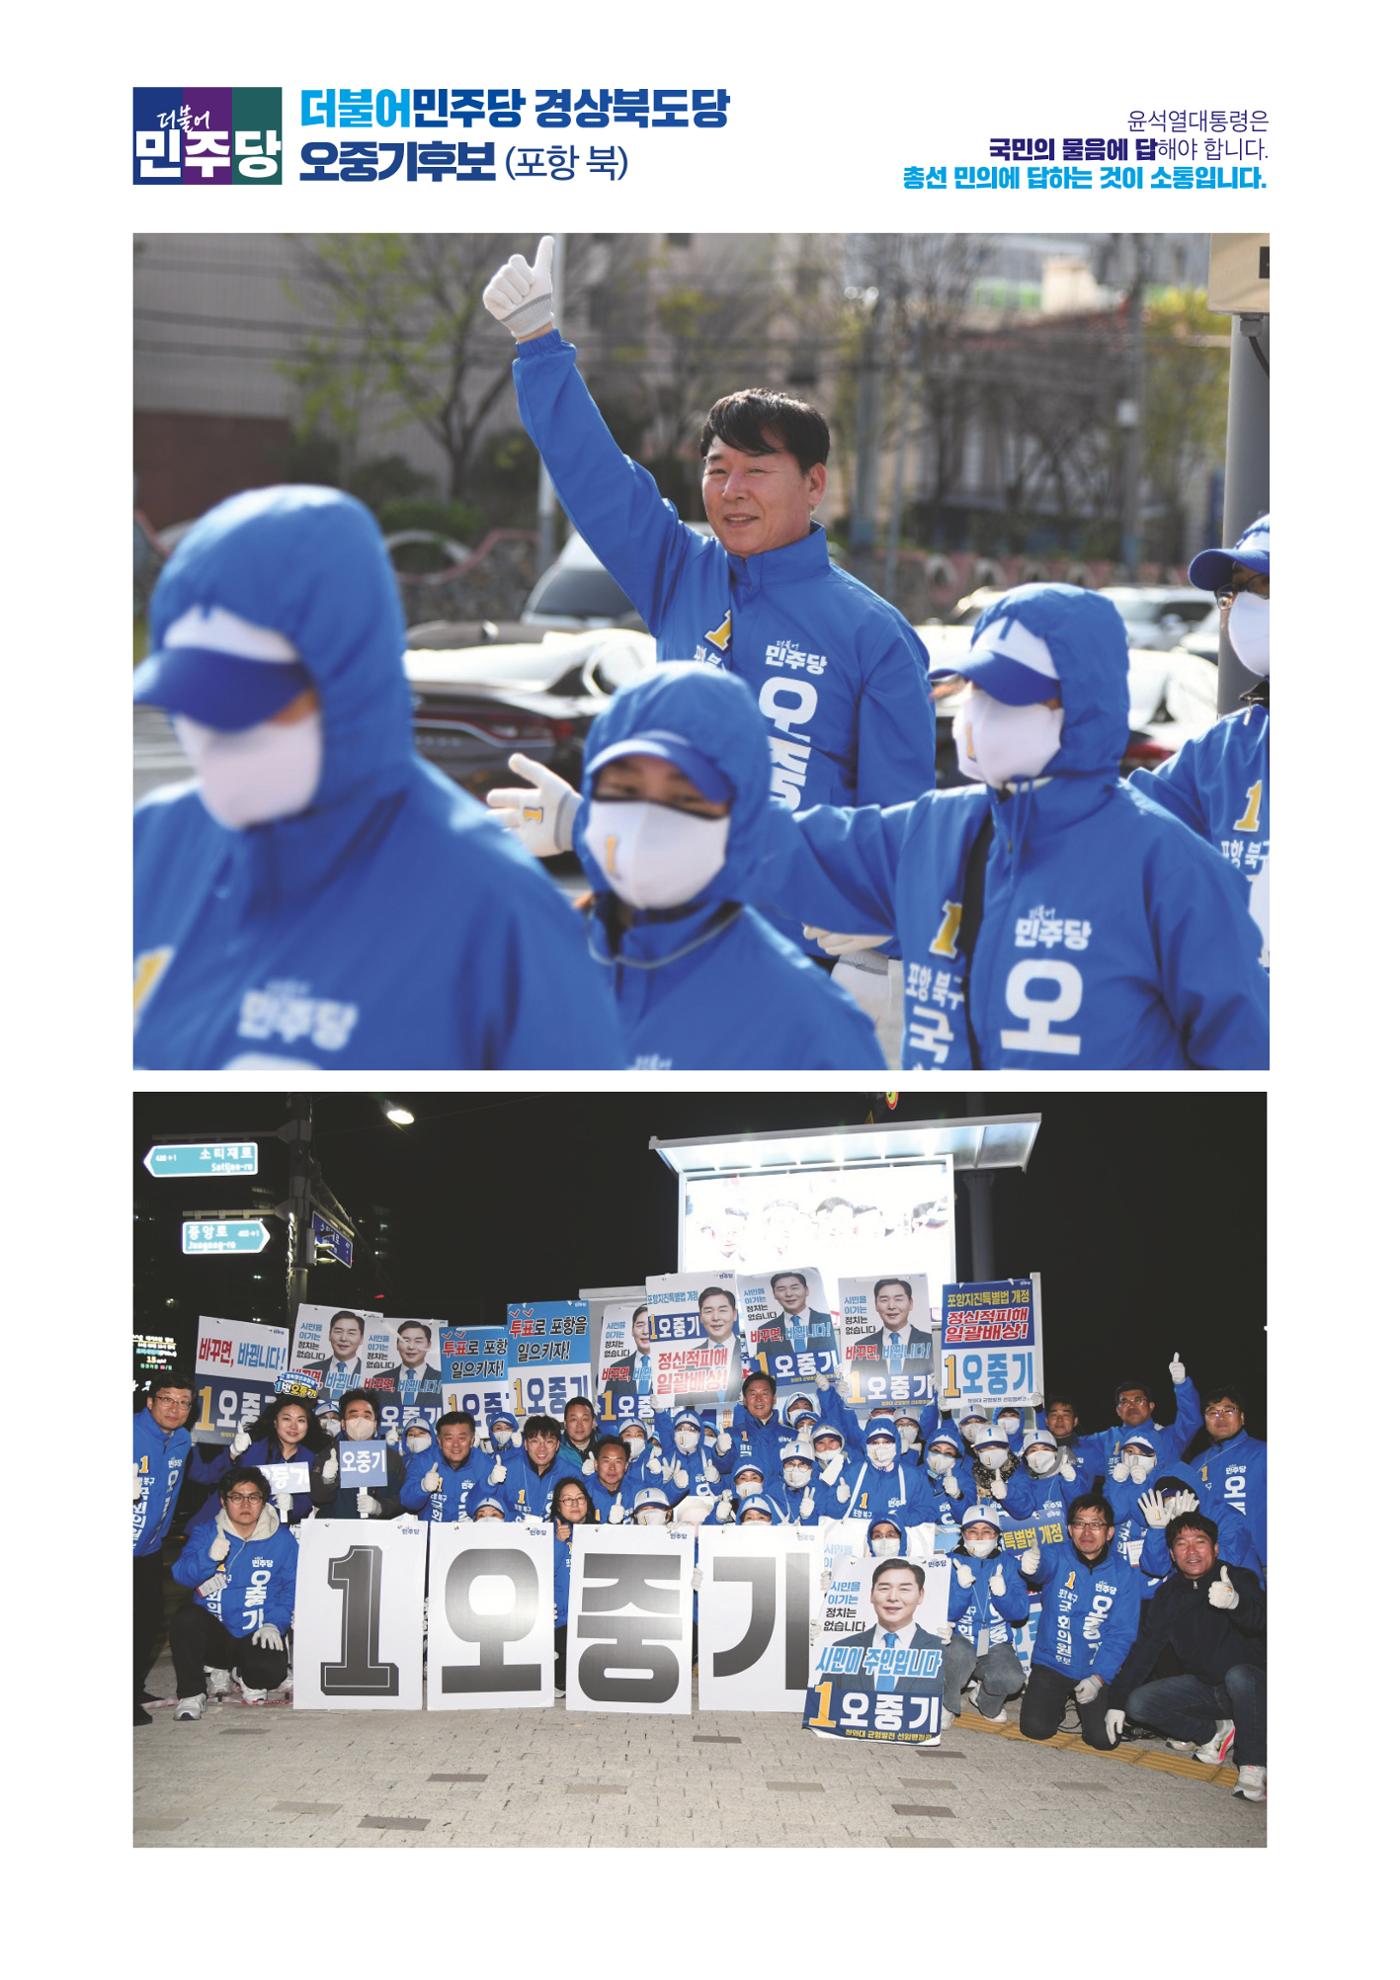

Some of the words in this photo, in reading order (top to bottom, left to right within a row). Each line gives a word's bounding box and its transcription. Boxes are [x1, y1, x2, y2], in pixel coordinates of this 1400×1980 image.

[765, 645, 828, 675] 민주당
[1233, 780, 1263, 832] 1
[929, 900, 962, 958] 1
[1015, 918, 1092, 950] 민주당
[906, 963, 932, 1002] 포항
[1011, 1289, 1030, 1303] 개정
[510, 1319, 546, 1337] 투표로
[550, 1316, 587, 1335] 포항을
[844, 1316, 868, 1325] 정치는
[947, 1306, 1028, 1325] 정신적피해
[659, 1316, 700, 1338] 오중기
[845, 1326, 876, 1335] 없습니다
[944, 1323, 1028, 1343] 일괄배상!
[198, 1338, 234, 1367] 바꾸면,
[237, 1342, 287, 1371] 바뀝니다!
[296, 1351, 325, 1360] 없습니다
[443, 1340, 479, 1357] 투표로
[518, 1341, 570, 1363] 일으키자!
[658, 1347, 728, 1371] 정신적피해
[452, 1360, 503, 1379] 일으키자!
[774, 1349, 837, 1377] 오중기
[944, 1355, 961, 1398] 1
[962, 1352, 1034, 1396] 오중기
[513, 1378, 527, 1417] 1
[867, 1375, 935, 1401] 오중기
[193, 1385, 215, 1432] 1
[216, 1389, 277, 1427] 오중
[601, 1390, 617, 1421] 1
[987, 1428, 994, 1438] 1
[139, 1455, 149, 1474] 1
[341, 1450, 386, 1474] 오중기
[860, 1492, 869, 1509] 1
[979, 1507, 986, 1517] 1
[1039, 1523, 1064, 1545] 개정
[831, 1581, 860, 1592] 시민을
[1064, 1571, 1076, 1590] 1
[828, 1594, 858, 1605] 이기는
[320, 1545, 399, 1696] 1
[441, 1548, 542, 1694] 오
[576, 1552, 683, 1703] 중
[712, 1552, 810, 1690] 기
[826, 1608, 857, 1619] 정치는
[824, 1621, 866, 1633] 없습니다
[815, 1647, 864, 1673] 시민이
[862, 1648, 942, 1678] 주인입니다
[809, 1681, 837, 1728] 1
[839, 1692, 940, 1734] 오중기
